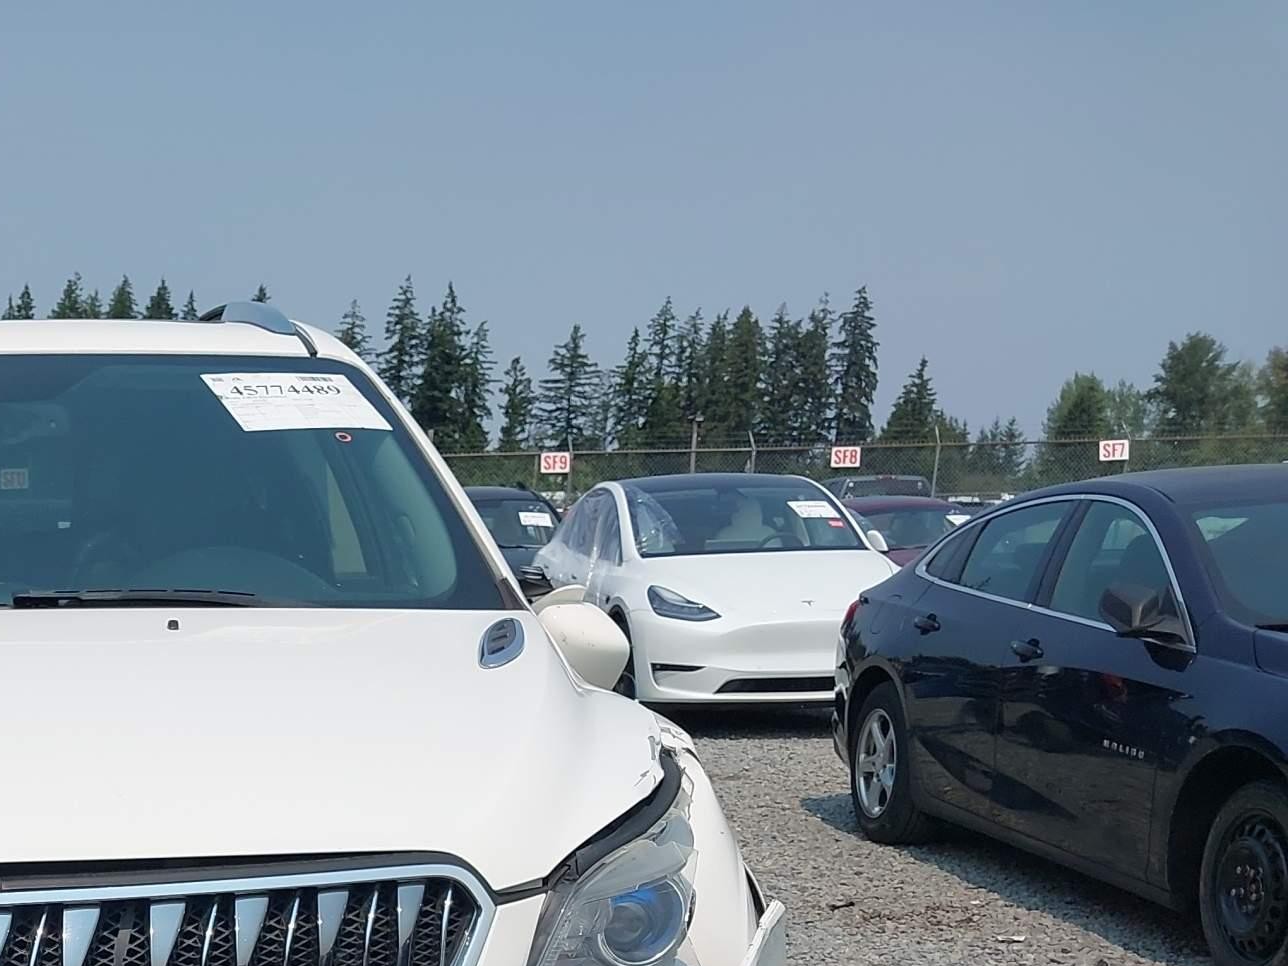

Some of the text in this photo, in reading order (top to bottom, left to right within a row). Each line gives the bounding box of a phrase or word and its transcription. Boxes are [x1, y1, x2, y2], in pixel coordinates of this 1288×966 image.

[229, 384, 342, 396] 45774489
[834, 449, 858, 465] SF8
[1103, 442, 1125, 458] SF7
[543, 455, 568, 470] SF9
